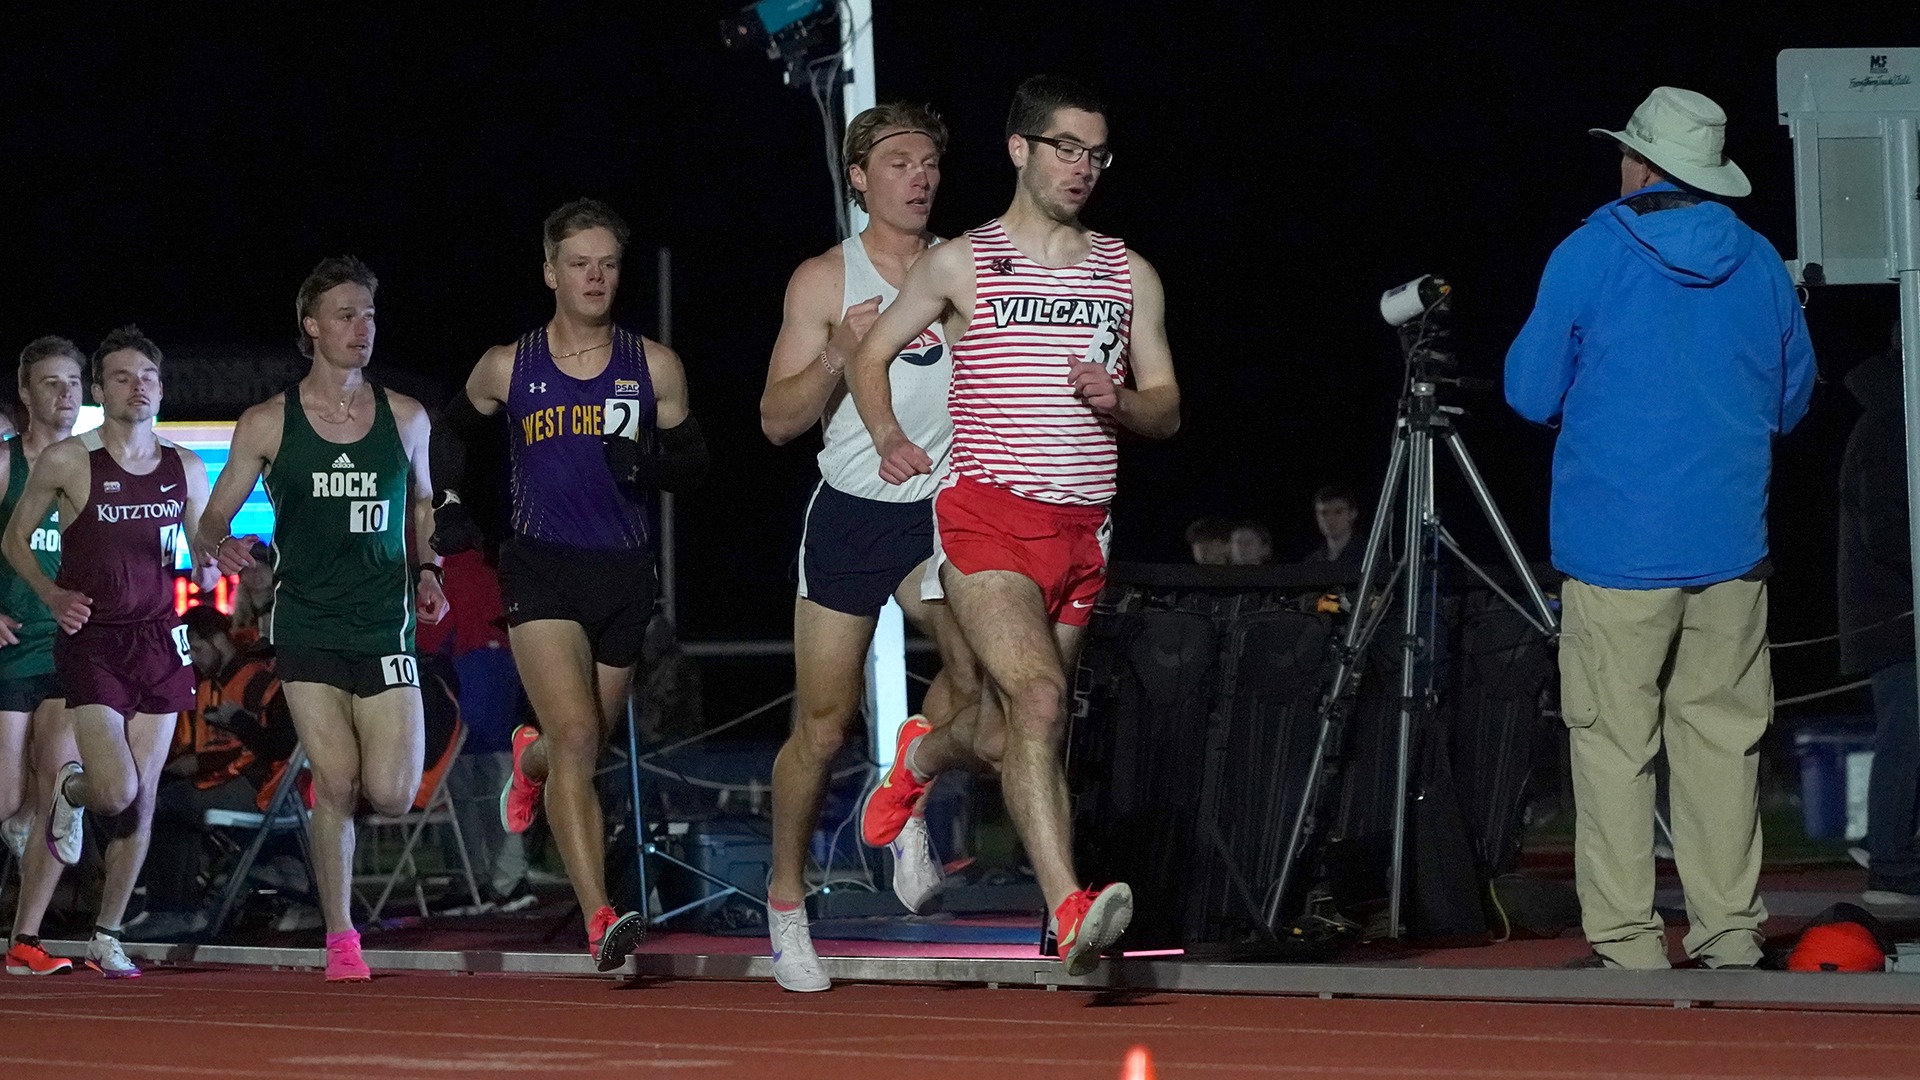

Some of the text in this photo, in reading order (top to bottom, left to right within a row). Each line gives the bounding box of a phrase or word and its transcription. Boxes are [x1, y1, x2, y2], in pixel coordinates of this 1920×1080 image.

[986, 297, 1125, 328] VULCANS
[616, 384, 638, 392] PSAC
[522, 405, 606, 446] WEST CHE
[613, 402, 631, 438] 2
[312, 472, 377, 497] ROCK
[96, 500, 183, 523] KUTZTOWN
[358, 504, 383, 531] 10
[30, 528, 61, 551] RO
[390, 658, 414, 683] 10
